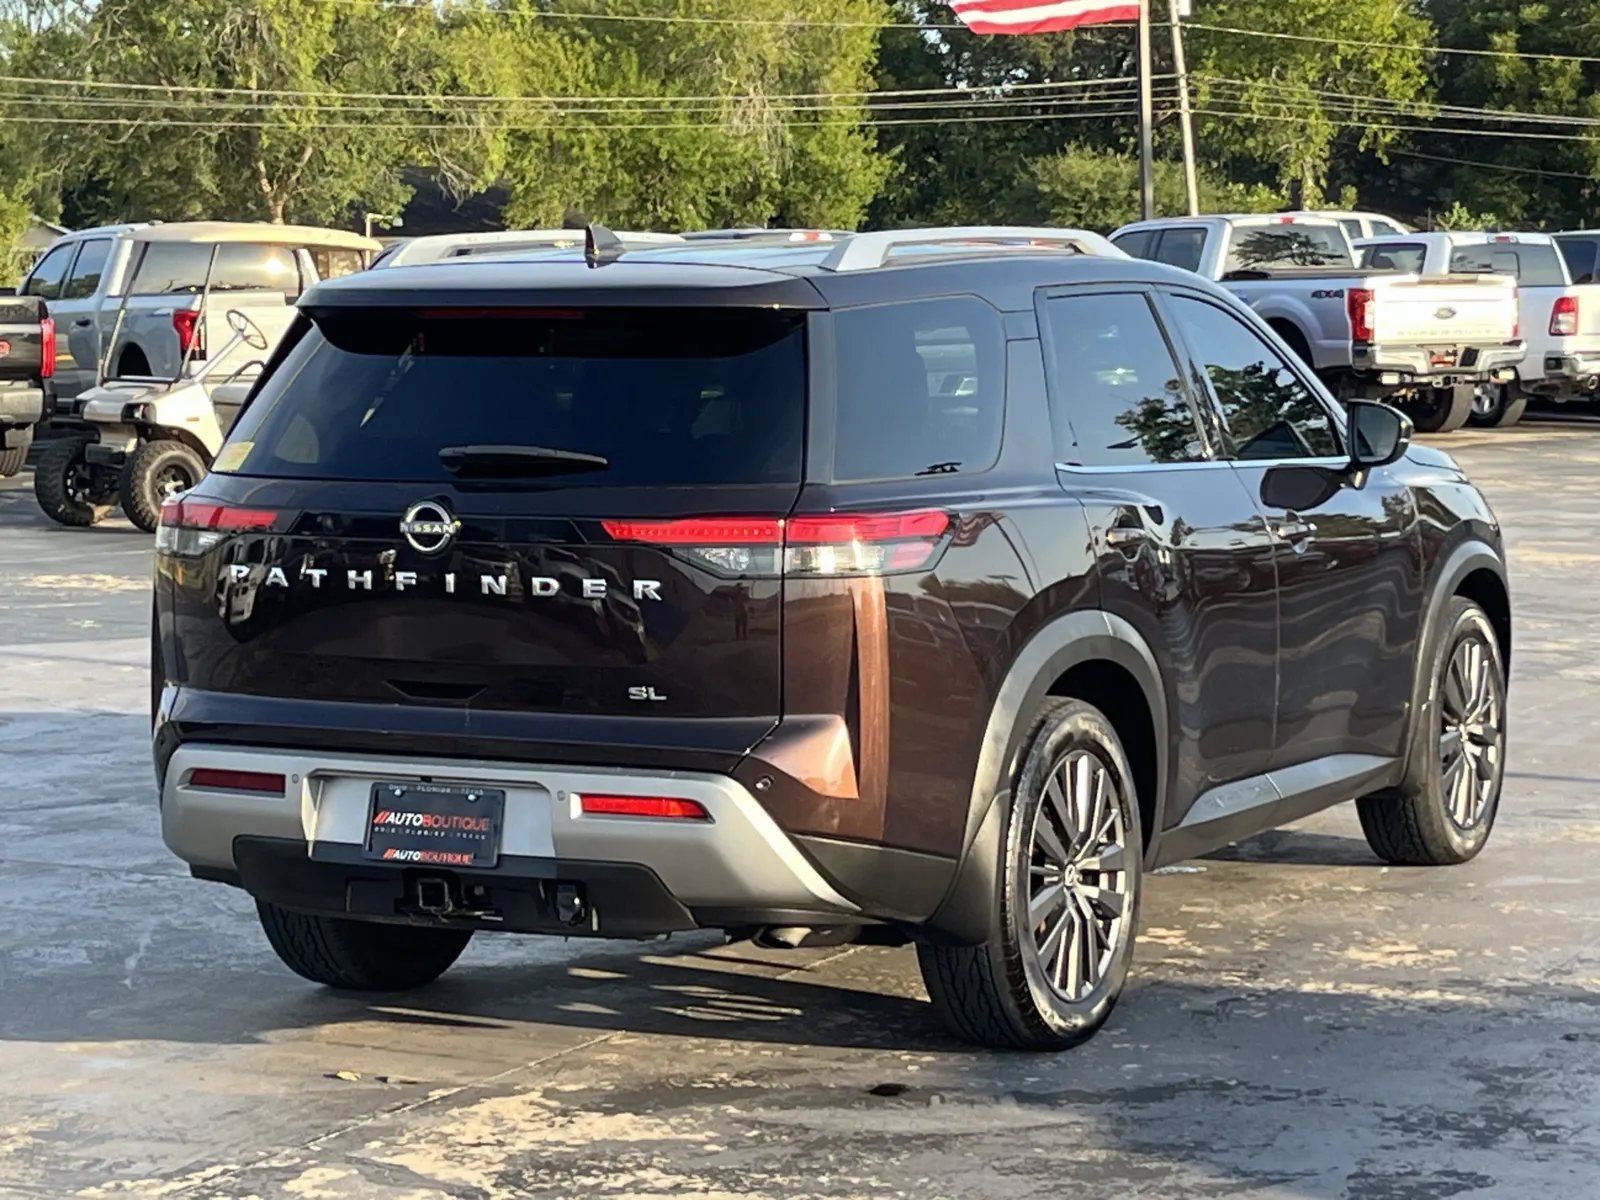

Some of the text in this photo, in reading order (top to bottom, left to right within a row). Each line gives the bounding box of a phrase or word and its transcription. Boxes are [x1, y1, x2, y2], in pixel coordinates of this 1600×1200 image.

[399, 521, 456, 533] NISSAN
[229, 564, 663, 601] PATHFINDER
[628, 686, 667, 701] SL
